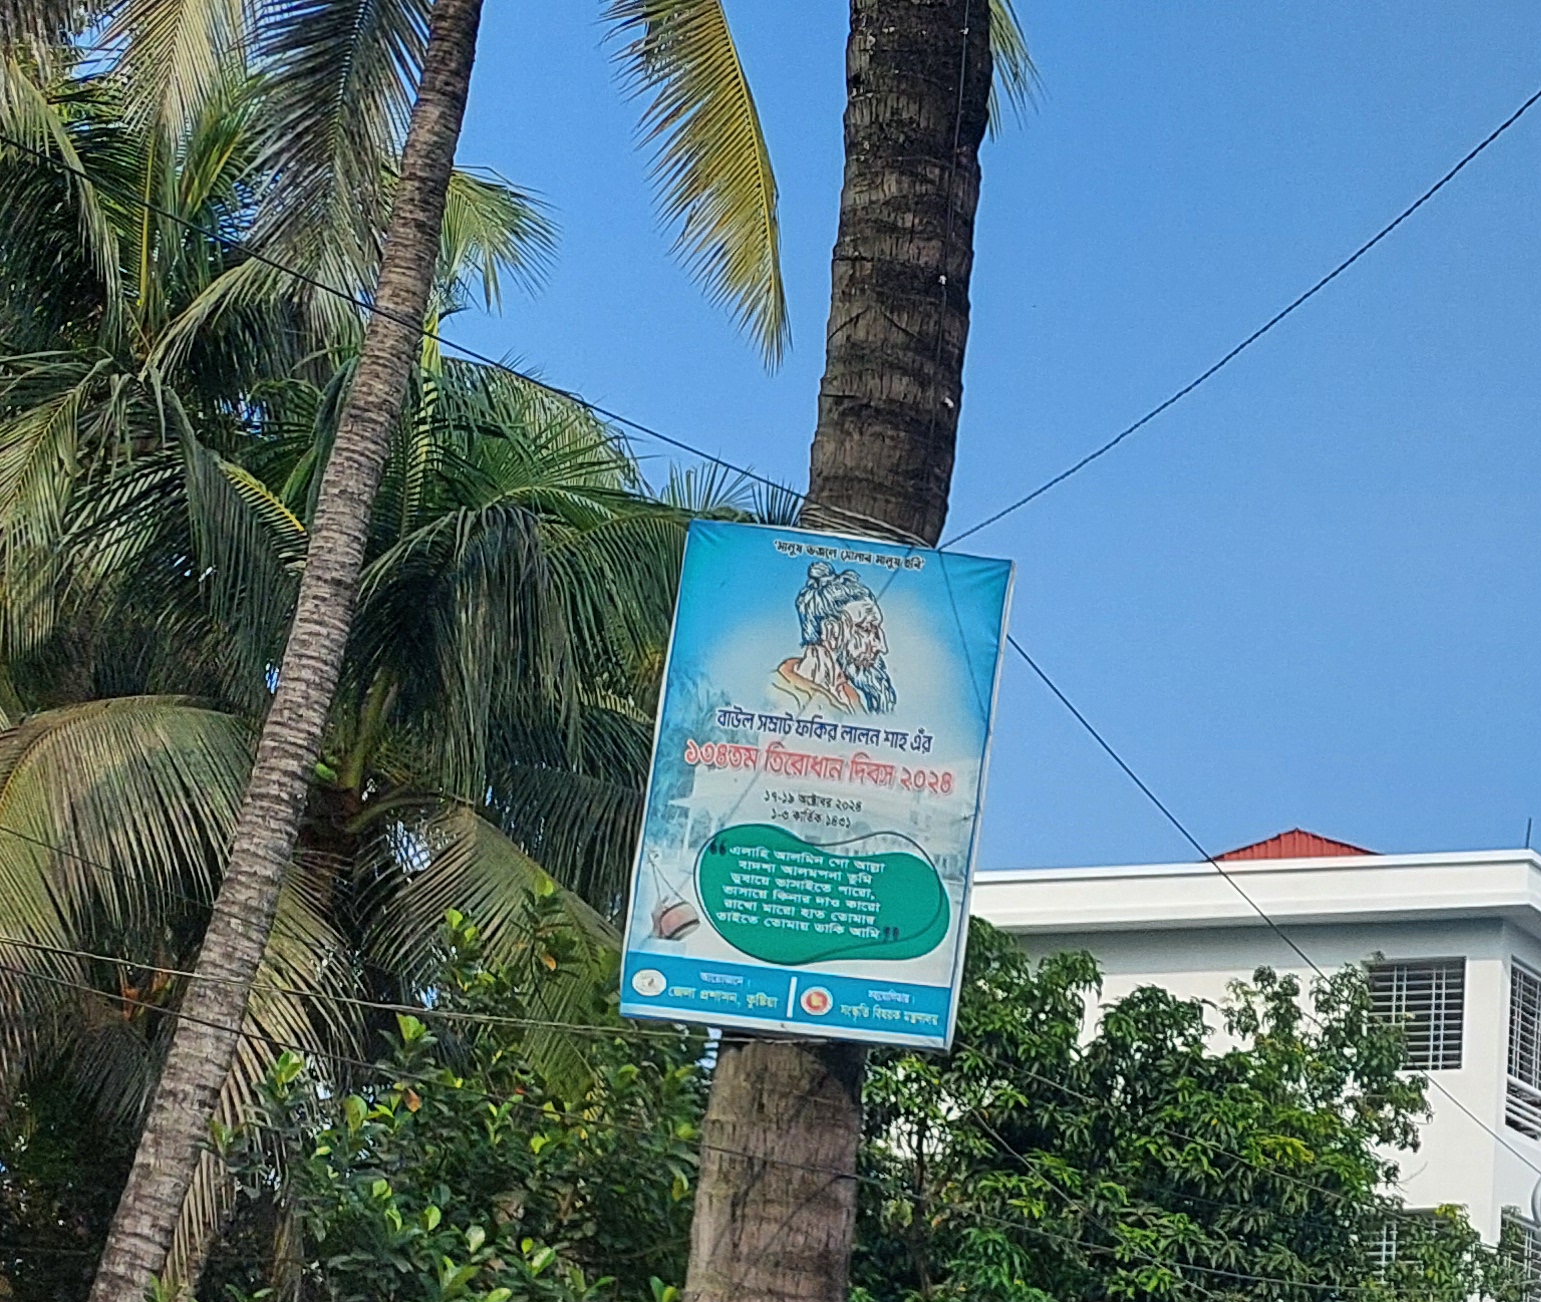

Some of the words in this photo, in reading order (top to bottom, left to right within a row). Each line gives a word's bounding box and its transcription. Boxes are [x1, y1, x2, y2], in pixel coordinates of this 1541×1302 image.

[717, 705, 754, 730] বাউল
[757, 711, 794, 736] সম্রাট
[796, 715, 838, 743] ফকির
[840, 724, 880, 748] লালন
[883, 729, 910, 752] শাহ
[910, 727, 933, 754] এঁর
[684, 738, 759, 772] ১৩৪তম
[764, 741, 844, 781] তিরোধান
[849, 751, 896, 787] দিবস
[899, 766, 954, 795] ২০২৪
[763, 789, 795, 806] ১৭-১৯
[797, 793, 833, 809] অক্টোবর
[835, 798, 863, 813] ২০২৪
[792, 806, 822, 824] কার্তিক
[825, 815, 852, 829] ১৪৩১
